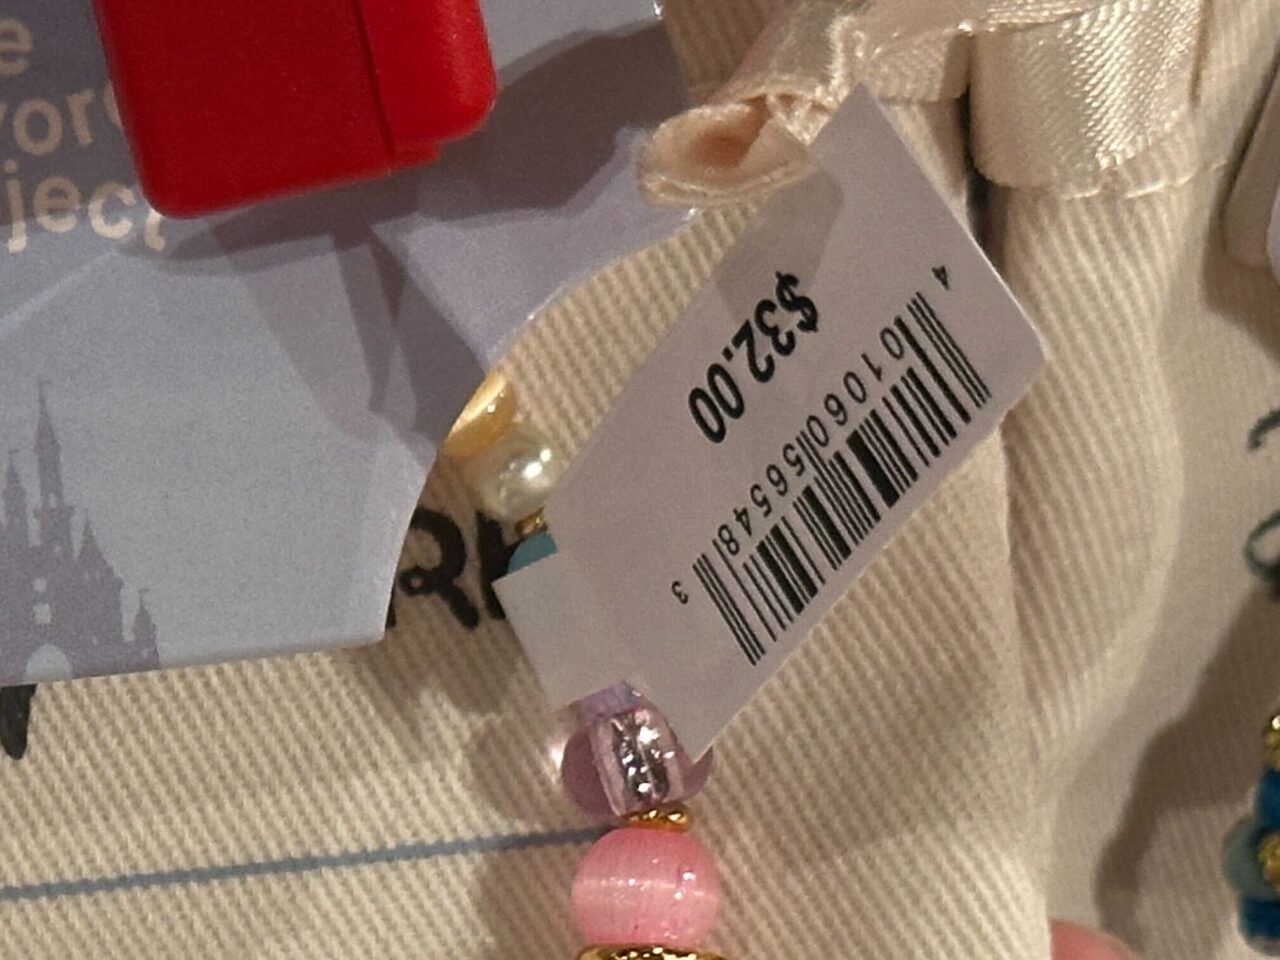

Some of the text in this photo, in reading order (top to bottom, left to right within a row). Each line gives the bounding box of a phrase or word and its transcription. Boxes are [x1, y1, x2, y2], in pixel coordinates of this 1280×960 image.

[931, 264, 952, 291] 4
[687, 270, 819, 444] $32.00
[670, 579, 690, 606] 3
